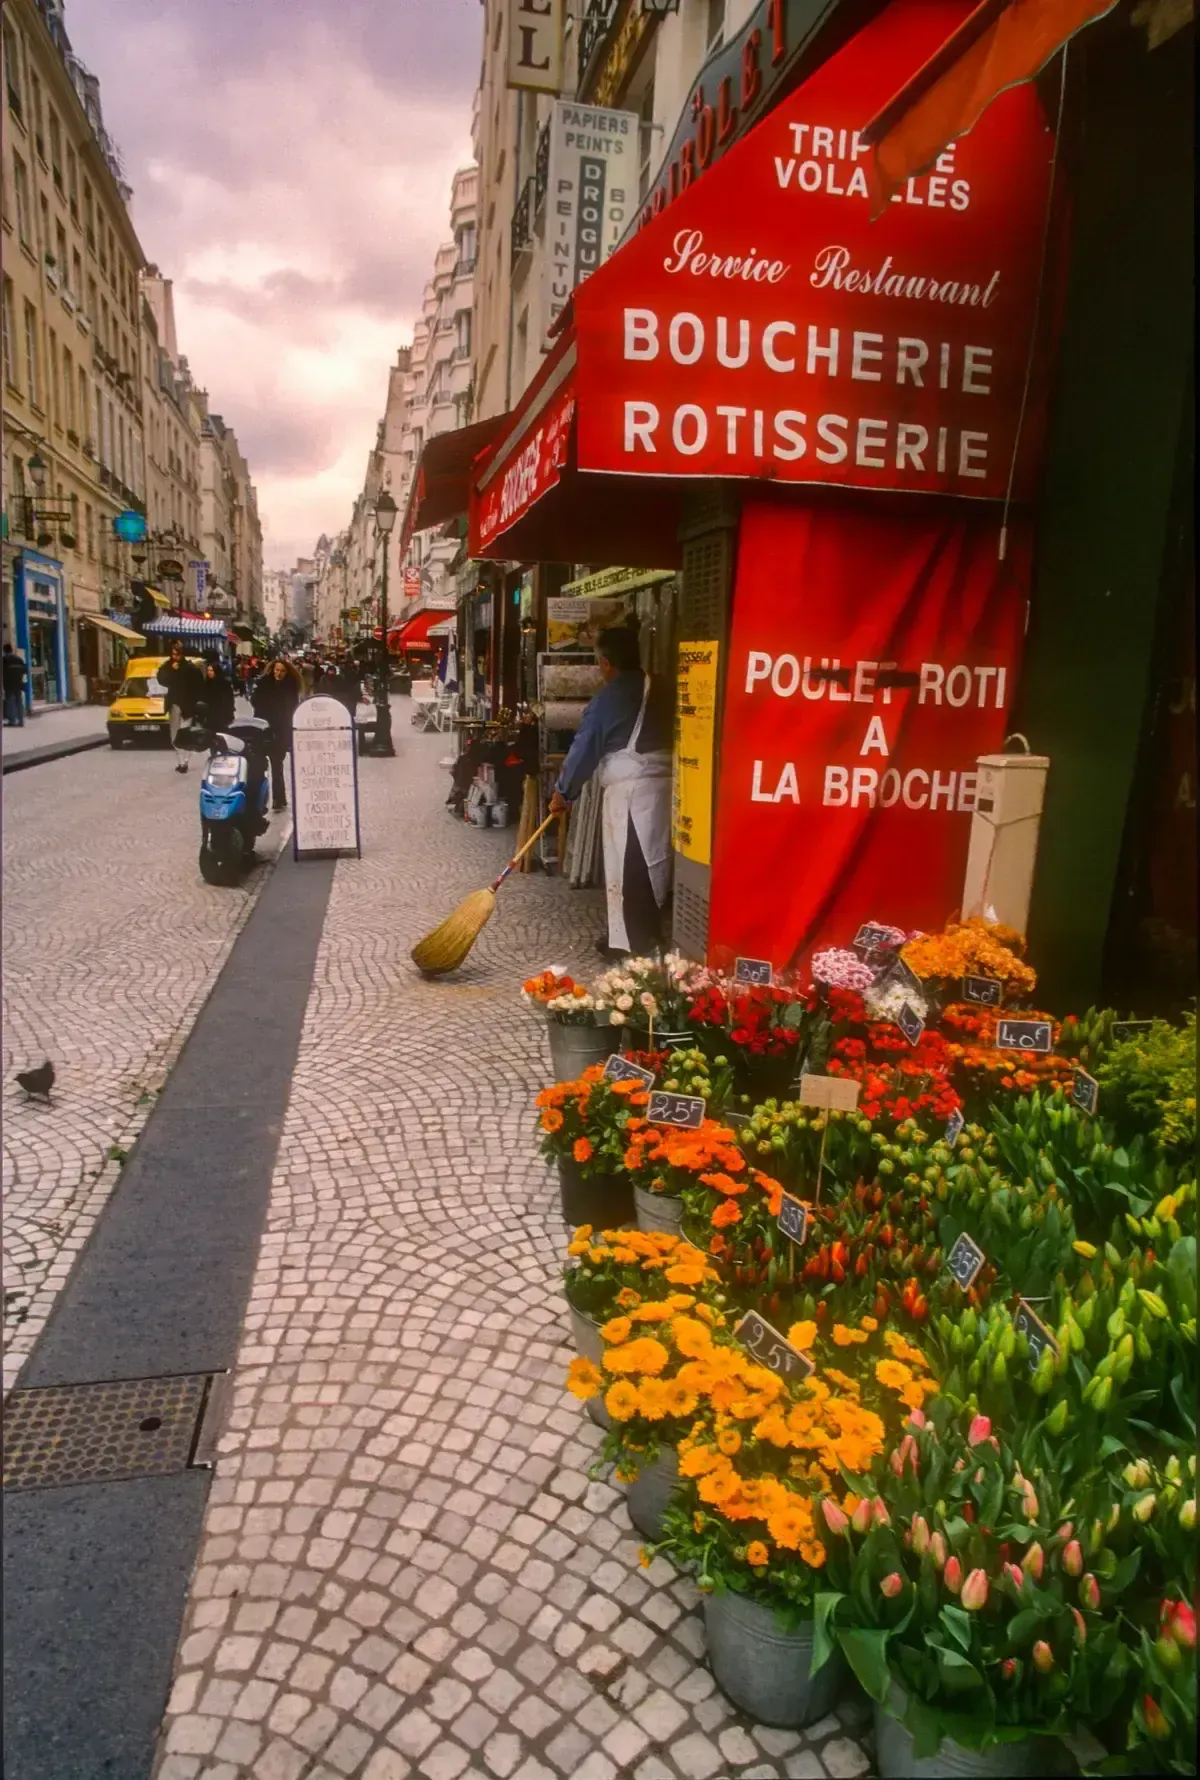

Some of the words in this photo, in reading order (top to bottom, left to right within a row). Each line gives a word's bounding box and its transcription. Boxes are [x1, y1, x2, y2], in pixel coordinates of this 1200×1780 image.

[562, 109, 629, 135] PAPIERS
[565, 132, 624, 155] PEINTS
[788, 123, 957, 174] TRIPE
[774, 157, 970, 211] VOLALES
[663, 229, 791, 284] Service
[810, 245, 1000, 309] Restaurant
[623, 308, 993, 395] BOUCHERIE
[623, 401, 989, 479] ROTISSERIE
[745, 650, 898, 704] POULET
[918, 662, 1006, 709] ROTI
[860, 715, 889, 756] A
[751, 760, 800, 804] LA
[822, 765, 977, 812] BROCHE
[1002, 1024, 1049, 1048] 40F
[650, 1095, 700, 1123] 25F
